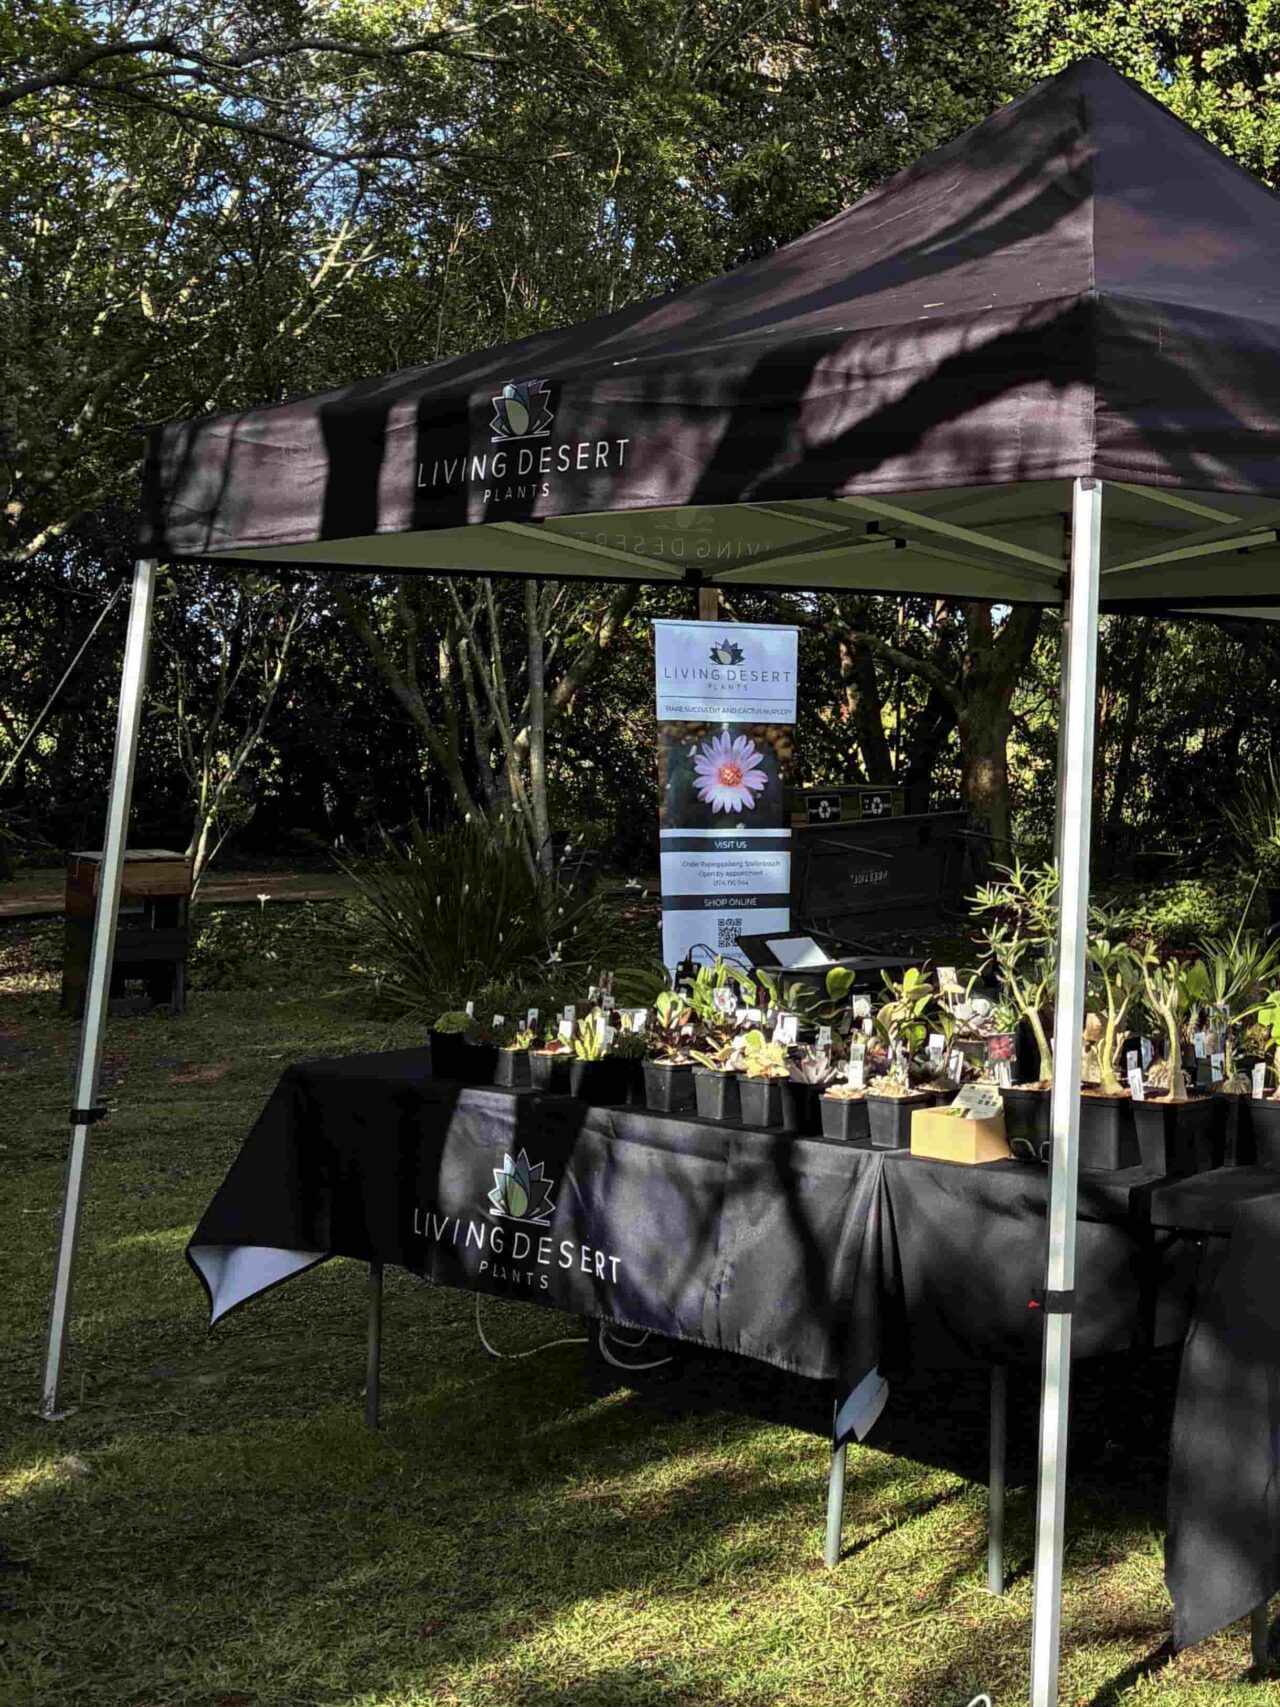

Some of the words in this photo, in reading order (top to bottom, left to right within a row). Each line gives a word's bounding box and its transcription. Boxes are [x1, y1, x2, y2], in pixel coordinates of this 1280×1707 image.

[417, 453, 507, 488] LIVING
[517, 438, 630, 475] DESERT
[483, 483, 550, 504] PLANTS
[664, 667, 720, 680] LIVING
[727, 670, 792, 683] DESERT
[707, 683, 749, 691] PLANTS
[714, 840, 735, 848] VISIT
[736, 840, 747, 848] US
[704, 898, 727, 907] SHOP
[729, 897, 757, 906] ONLINE
[414, 1208, 504, 1253] LIVING
[512, 1232, 622, 1284] DESERT
[479, 1260, 549, 1289] PLANTS
